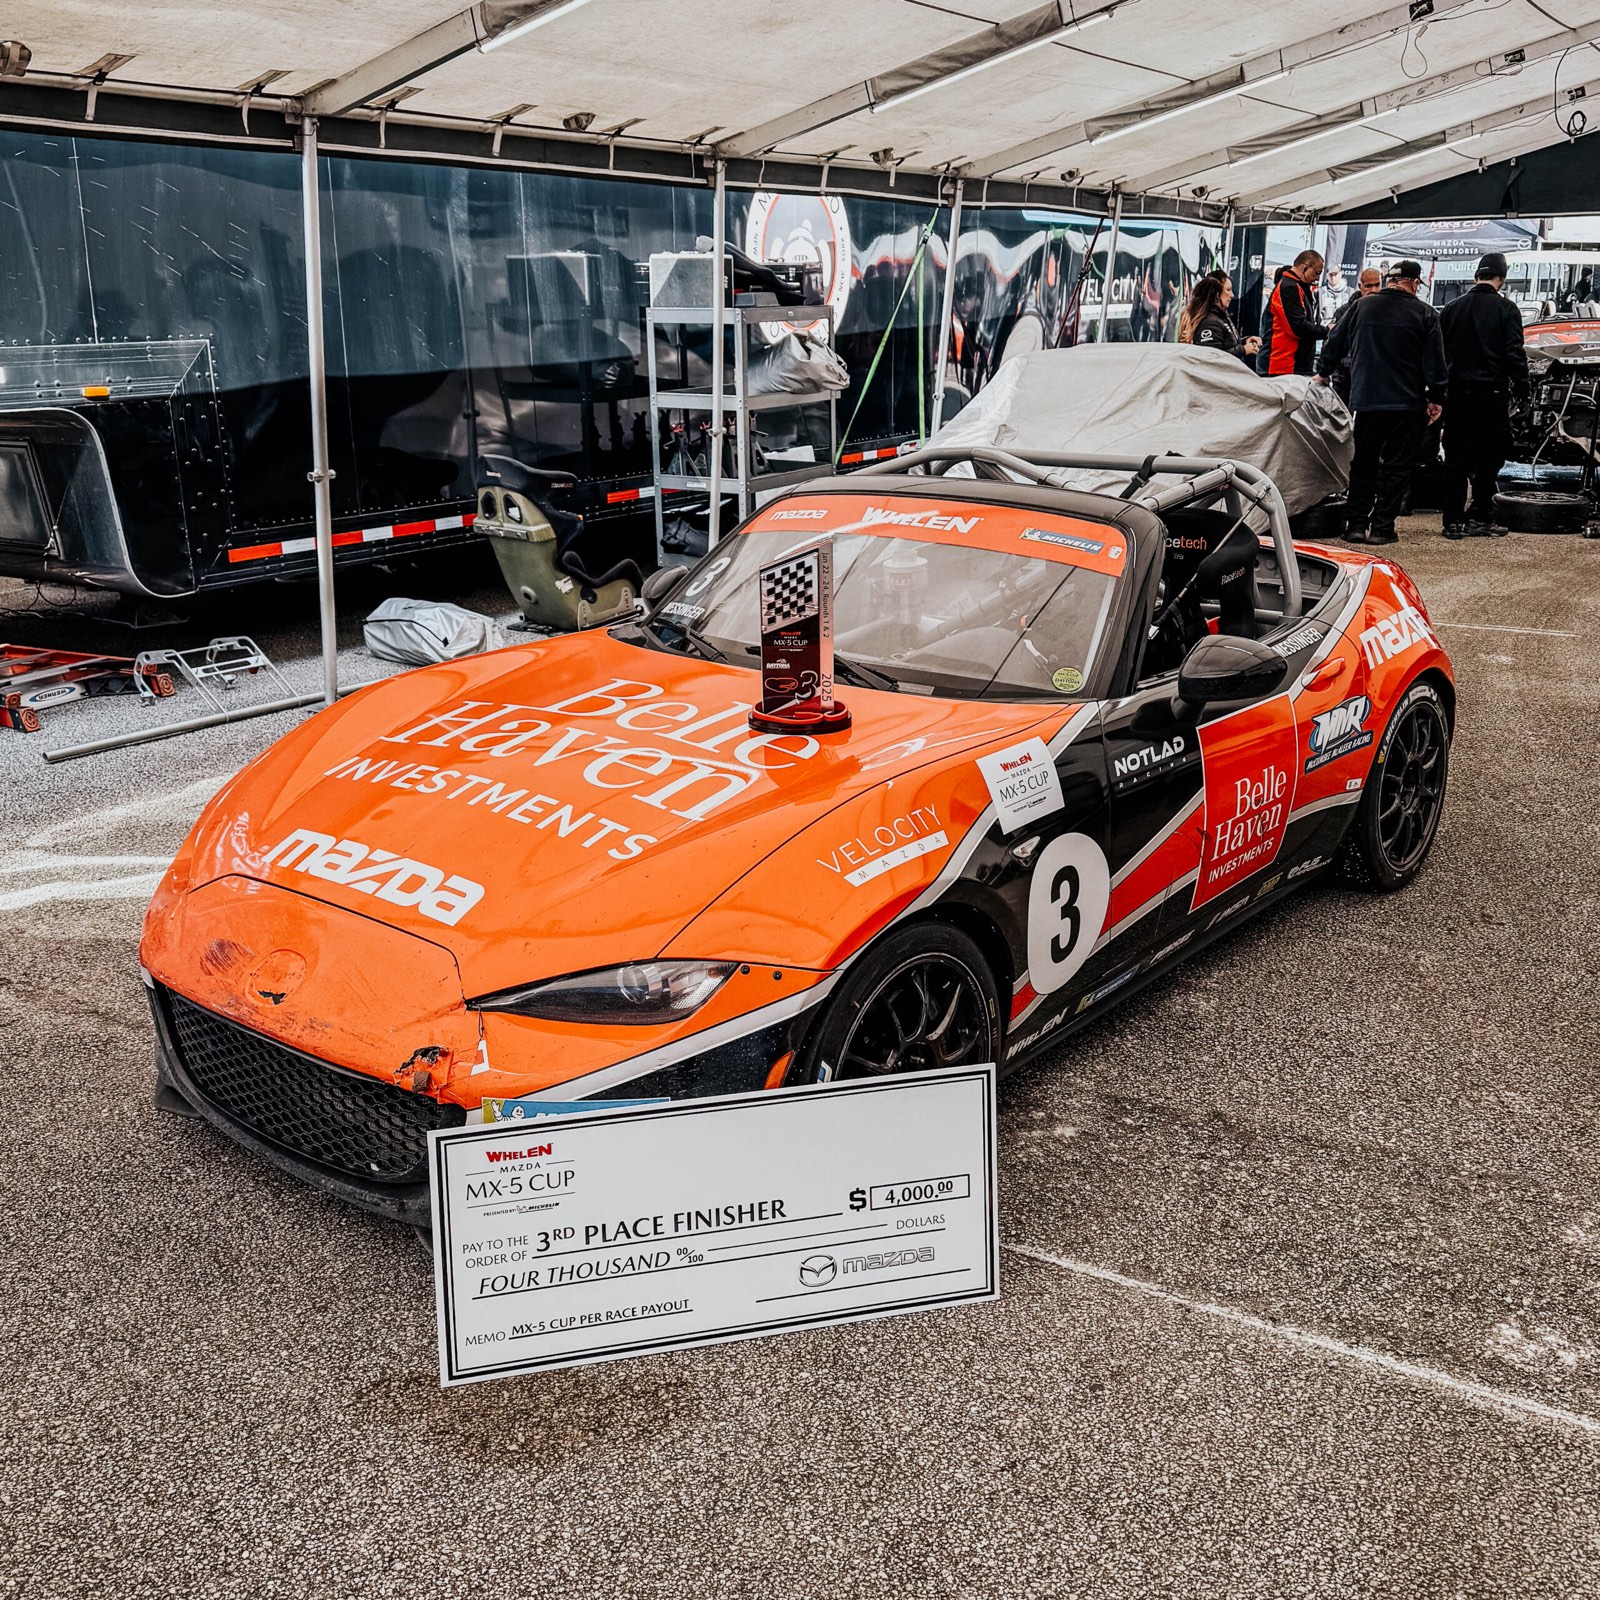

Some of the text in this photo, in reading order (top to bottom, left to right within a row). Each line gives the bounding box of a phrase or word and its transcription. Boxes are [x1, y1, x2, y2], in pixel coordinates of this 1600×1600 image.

[1418, 248, 1479, 256] MOTORSPORTS
[860, 506, 980, 534] WHELEN
[1041, 533, 1103, 552] MICHELIN
[1165, 536, 1208, 551] cetech
[685, 556, 731, 597] 3
[822, 565, 830, 575] 22
[1220, 566, 1246, 586] Racetech
[660, 601, 706, 620] MESSINGER
[1271, 627, 1324, 658] MESSINGER
[38, 689, 67, 700] WERNER
[821, 674, 832, 702] 2025
[539, 676, 821, 771] Belle
[377, 699, 762, 822] Haven
[1000, 752, 1032, 772] WHELEN
[1114, 736, 1185, 777] NOTLAD
[1000, 770, 1050, 802] MX-5 CUP
[1011, 767, 1031, 780] MAZDA
[1235, 765, 1287, 818] Belle
[323, 756, 659, 860] INVESTMENTS
[816, 803, 941, 873] VELOCITY
[1210, 803, 1282, 862] Haven
[858, 836, 942, 880] MAZDA
[1208, 837, 1275, 884] INVESTMENTS
[262, 828, 485, 928] mazda
[1050, 865, 1081, 964] 3
[1006, 1007, 1069, 1060] WHELEN
[486, 1143, 553, 1163] WHELEN
[499, 1162, 541, 1174] MAZDA
[466, 1170, 575, 1201] MX-5 CUP
[849, 1187, 867, 1212] $
[462, 1199, 787, 1254] PAY TO THE 3RD PLACE FINISHER
[896, 1214, 946, 1230] DOLLARS
[465, 1250, 528, 1268] ORDER OF
[479, 1269, 541, 1295] FOUR
[546, 1251, 671, 1285] THOUSAND
[842, 1246, 936, 1275] mazda
[465, 1299, 690, 1347] MEMO MX-5 CUP PER RACE PAYOUT
